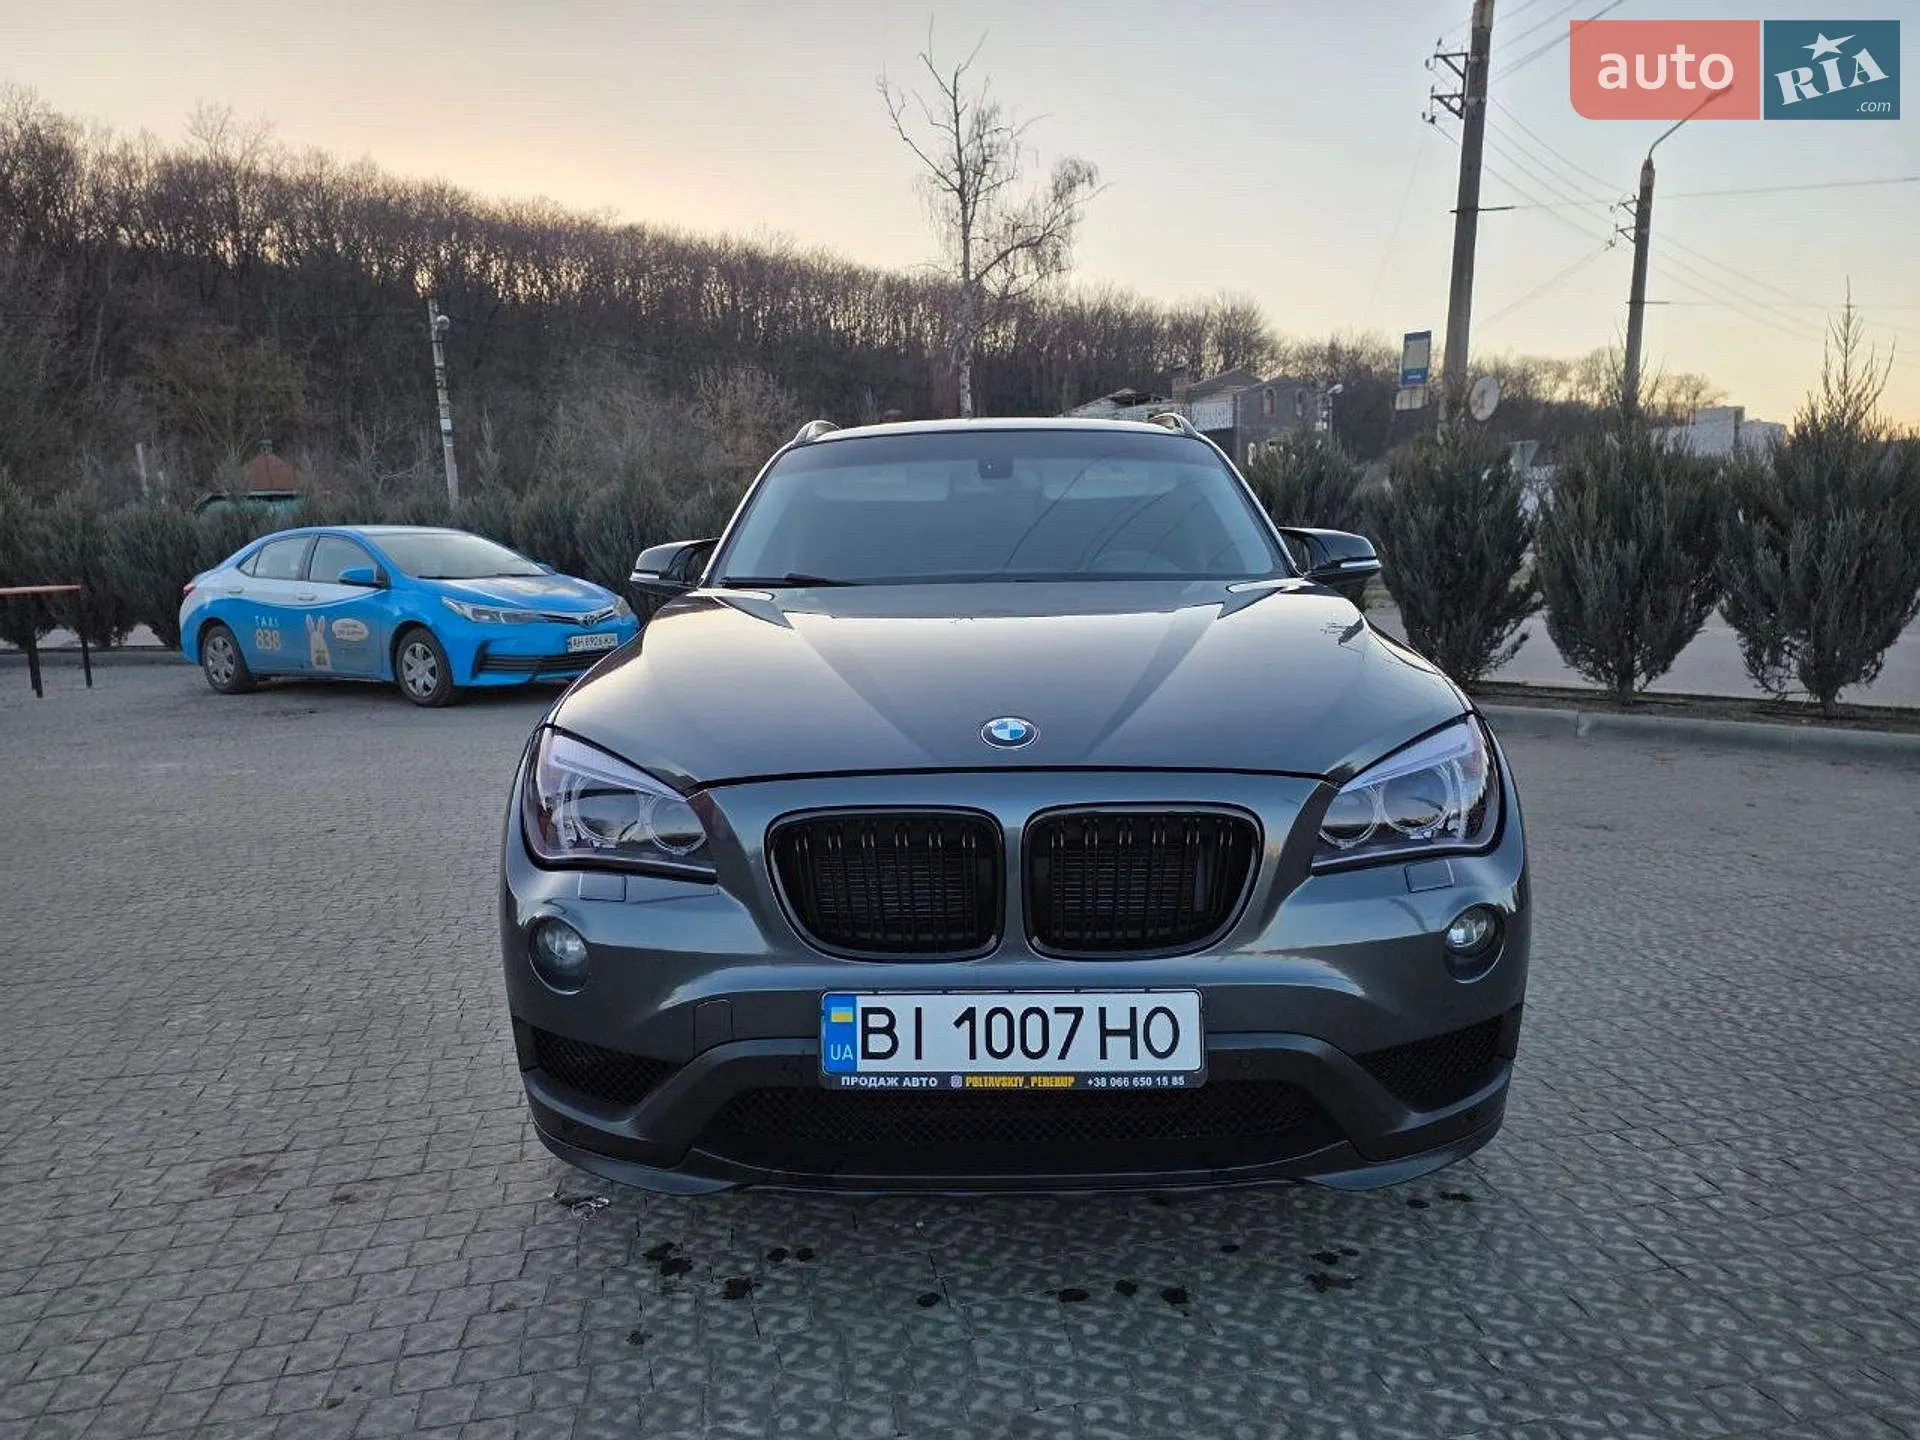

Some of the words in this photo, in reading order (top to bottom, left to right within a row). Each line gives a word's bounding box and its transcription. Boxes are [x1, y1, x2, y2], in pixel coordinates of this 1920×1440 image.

[256, 628, 281, 649] 838
[861, 1007, 923, 1060] BI
[953, 1006, 1085, 1060] 1007
[1098, 1006, 1180, 1060] HO
[830, 1043, 854, 1061] UA
[841, 1076, 899, 1088] ПРОДАЖ
[902, 1076, 938, 1088] АВТО
[1087, 1076, 1107, 1087] +38
[1110, 1076, 1130, 1087] 066
[1132, 1076, 1152, 1087] 650
